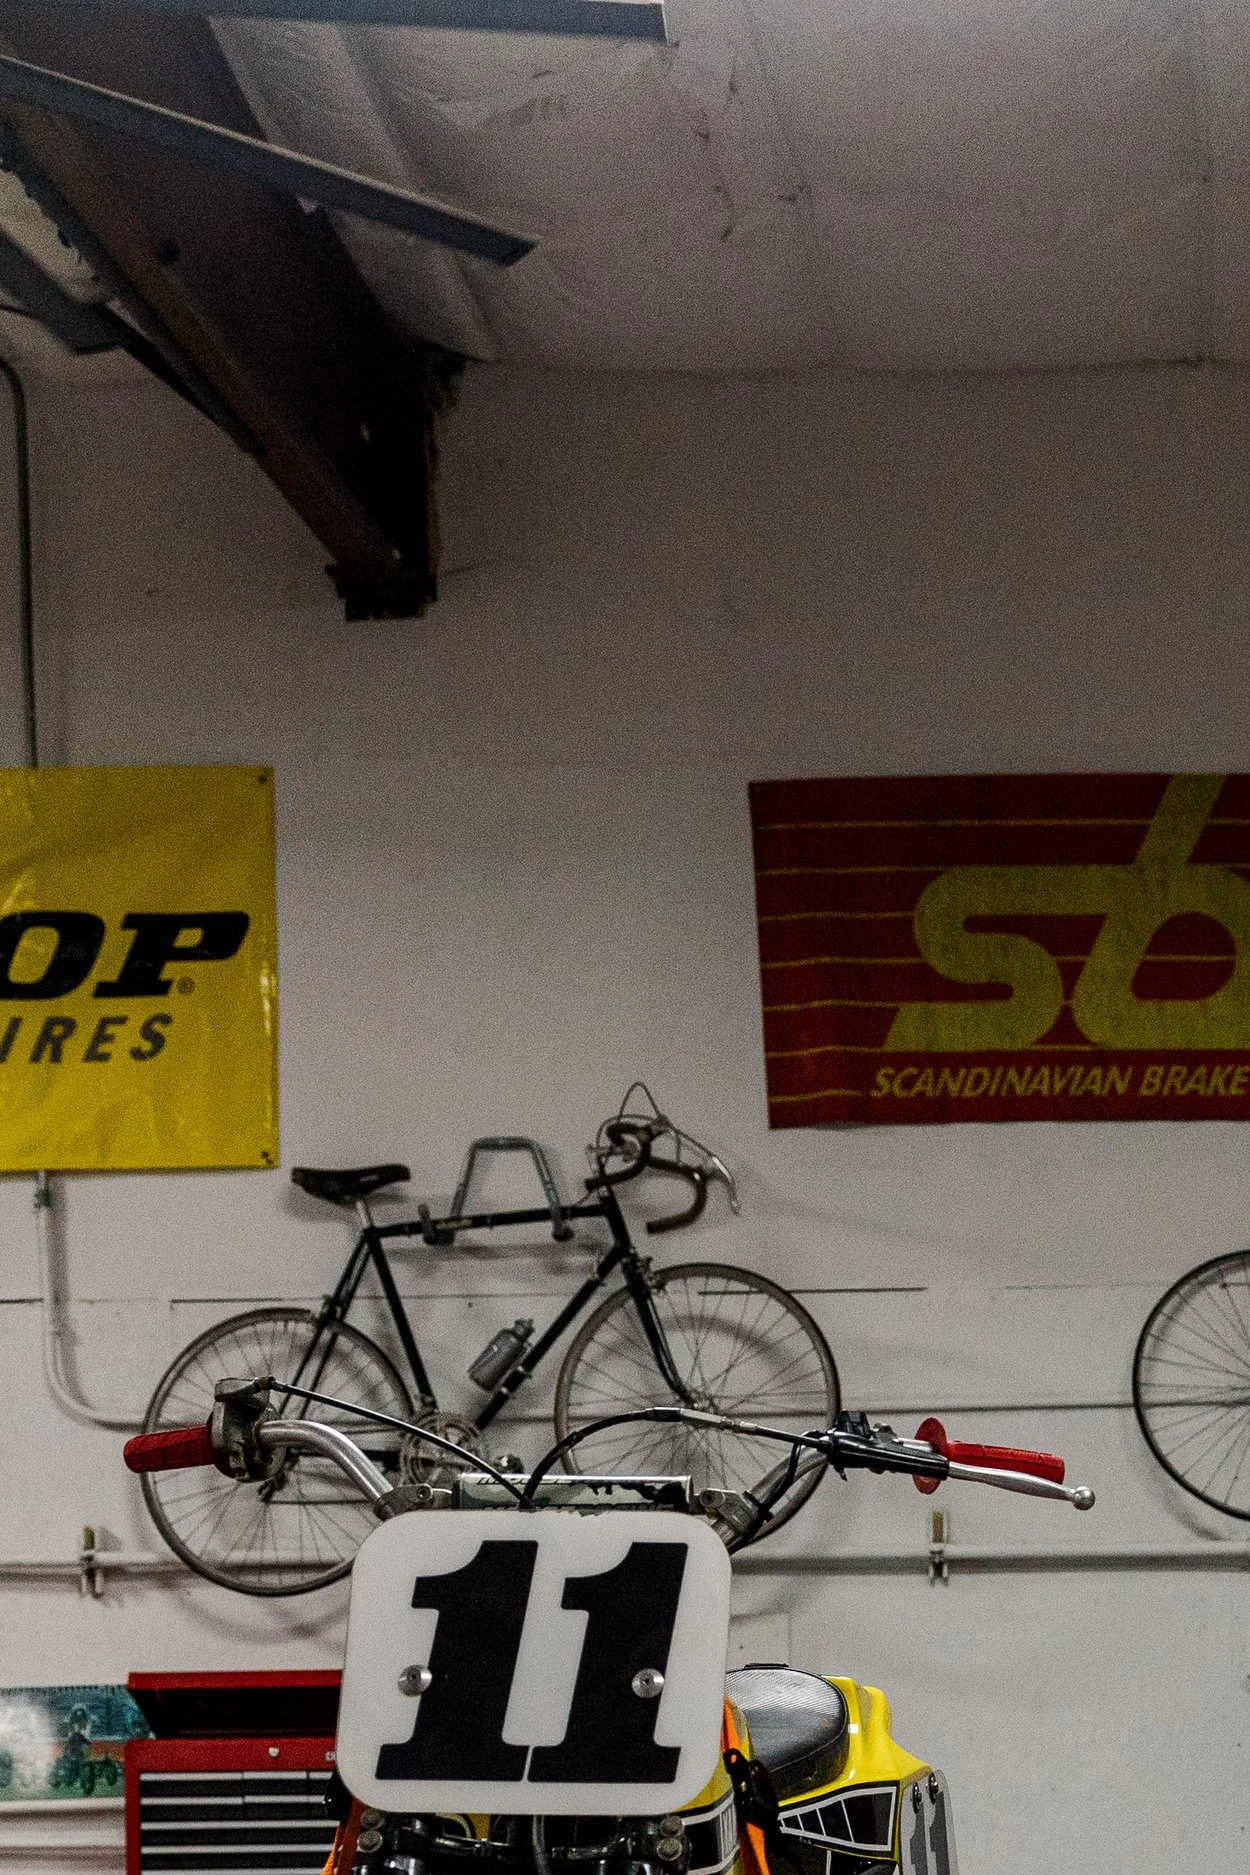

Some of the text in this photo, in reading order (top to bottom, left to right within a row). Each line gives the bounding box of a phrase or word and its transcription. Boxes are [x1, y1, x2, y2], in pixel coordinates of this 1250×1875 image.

[0, 1012, 173, 1064] IRES
[871, 1065, 1133, 1098] SCANDINAVIAN
[1139, 1066, 1249, 1096] BRAKE
[375, 1539, 690, 1783] 11
